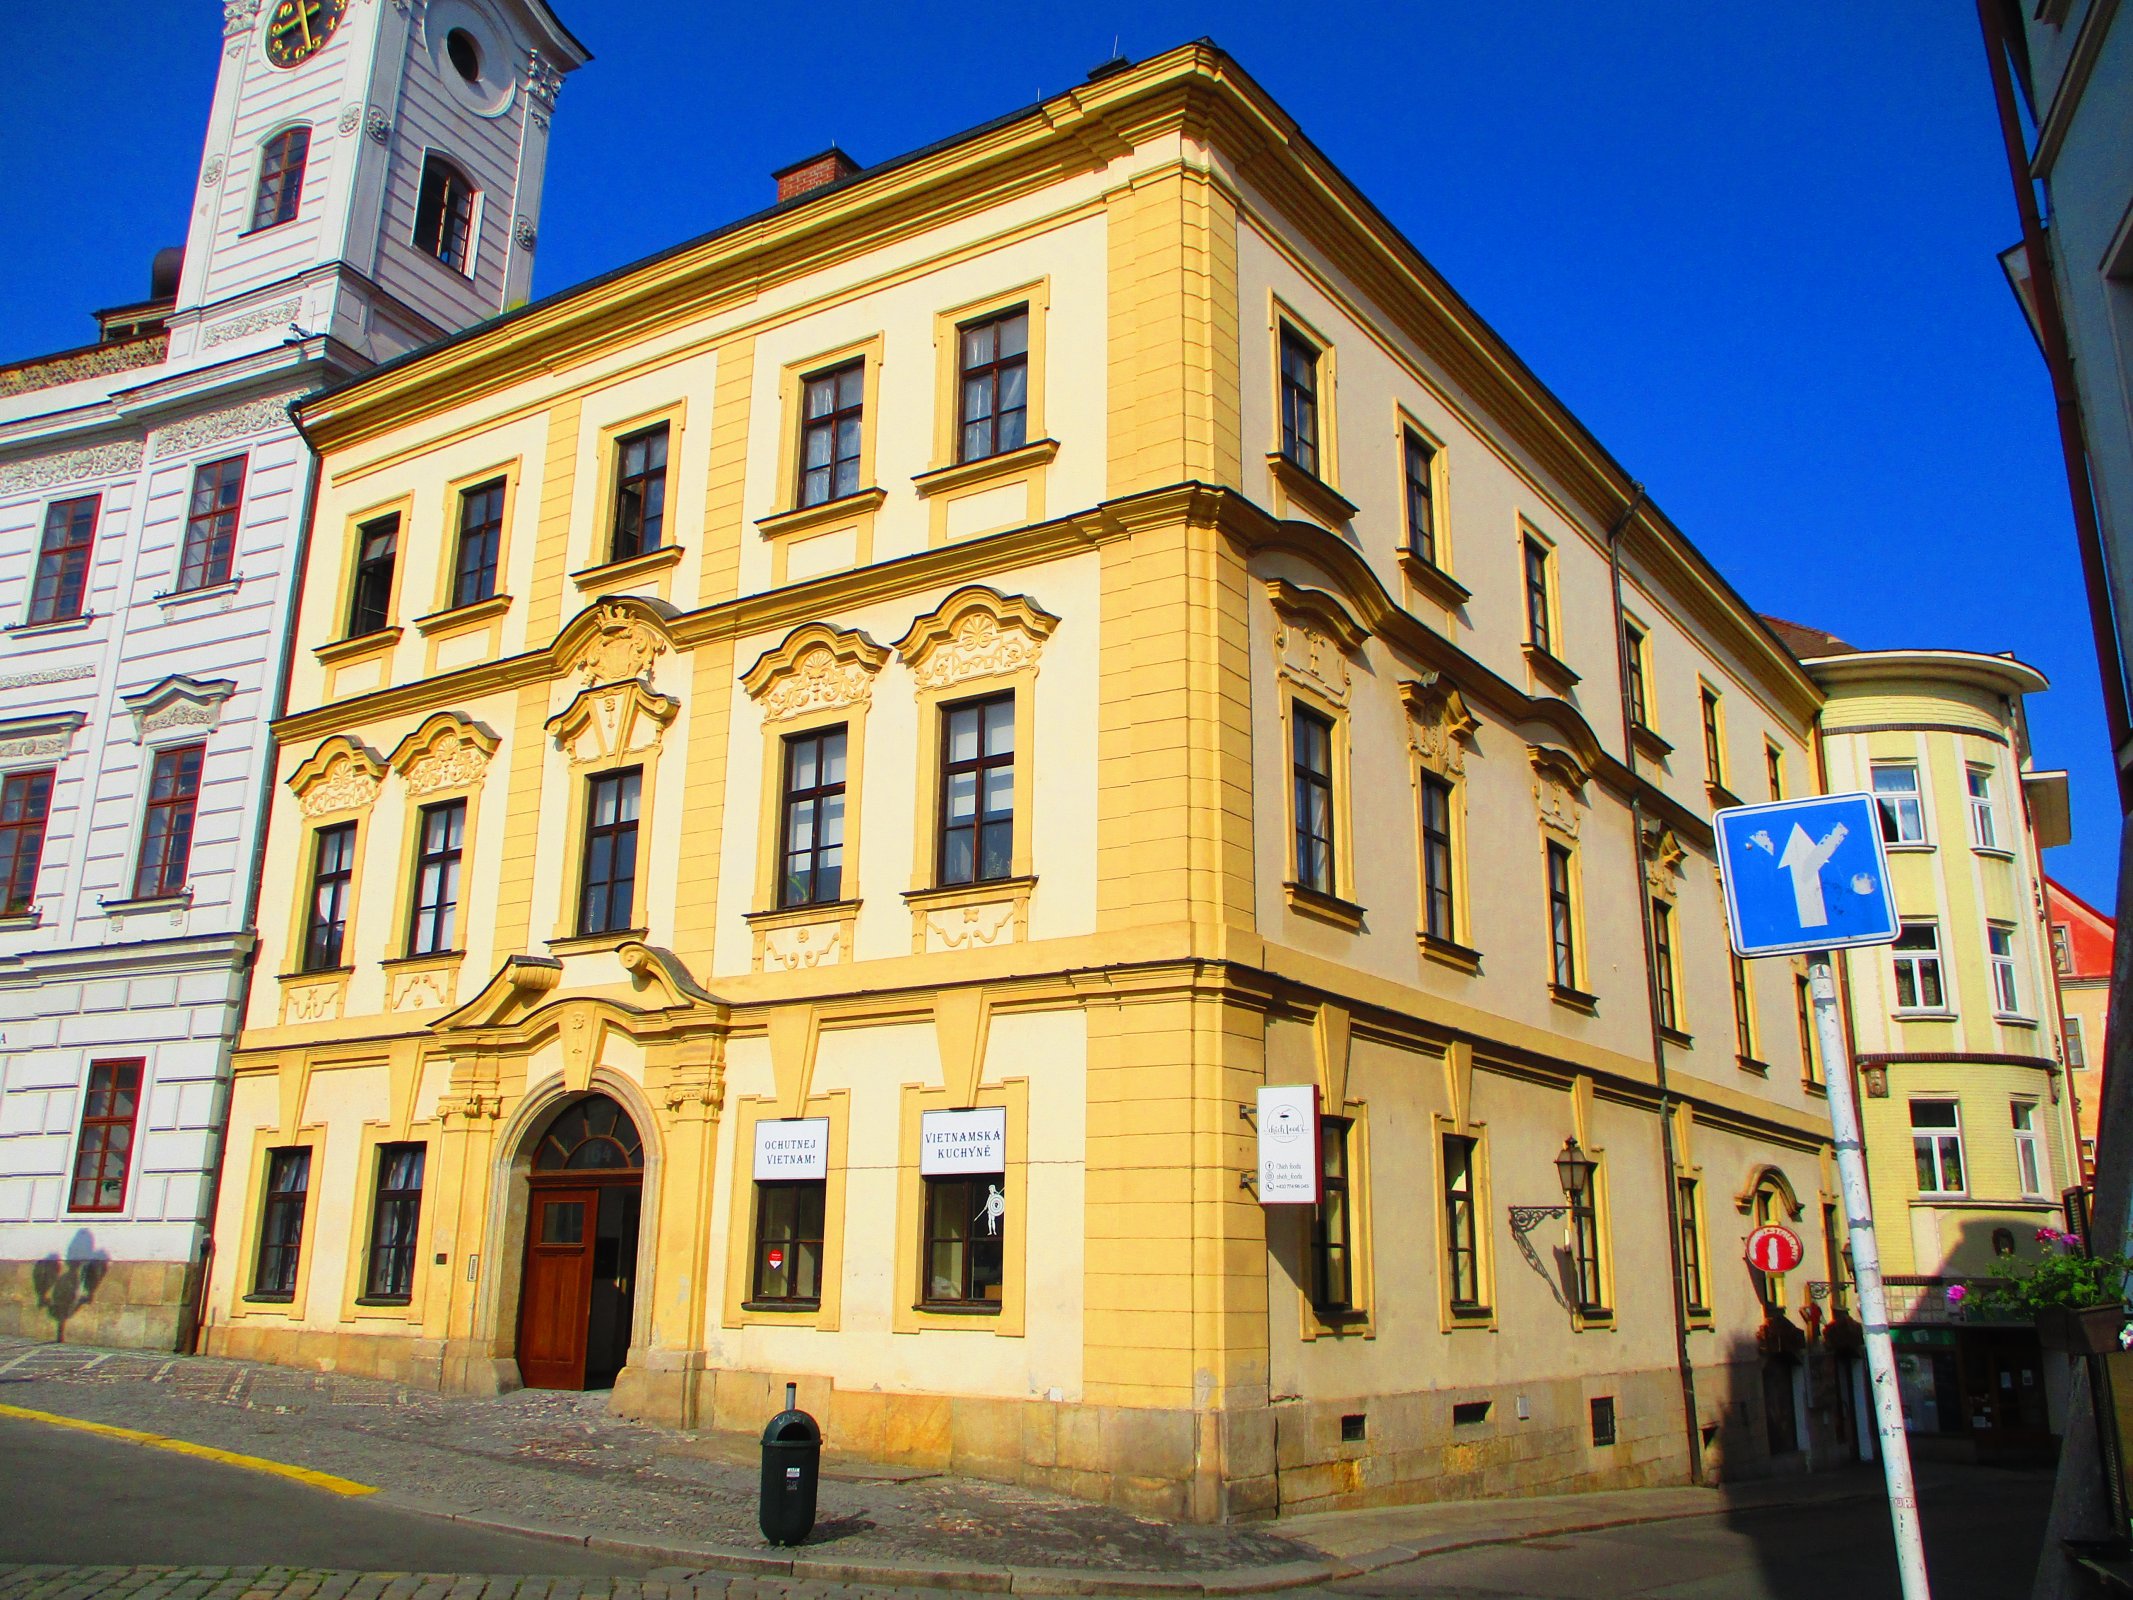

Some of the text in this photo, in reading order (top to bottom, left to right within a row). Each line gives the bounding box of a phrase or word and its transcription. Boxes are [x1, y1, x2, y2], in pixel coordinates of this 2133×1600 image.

[925, 1128, 1001, 1144] VIETNAMSKÁ
[764, 1139, 816, 1150] OCHUTNEJ
[937, 1145, 991, 1159] KUCHYNĚ
[767, 1154, 816, 1165] VIETNAM!
